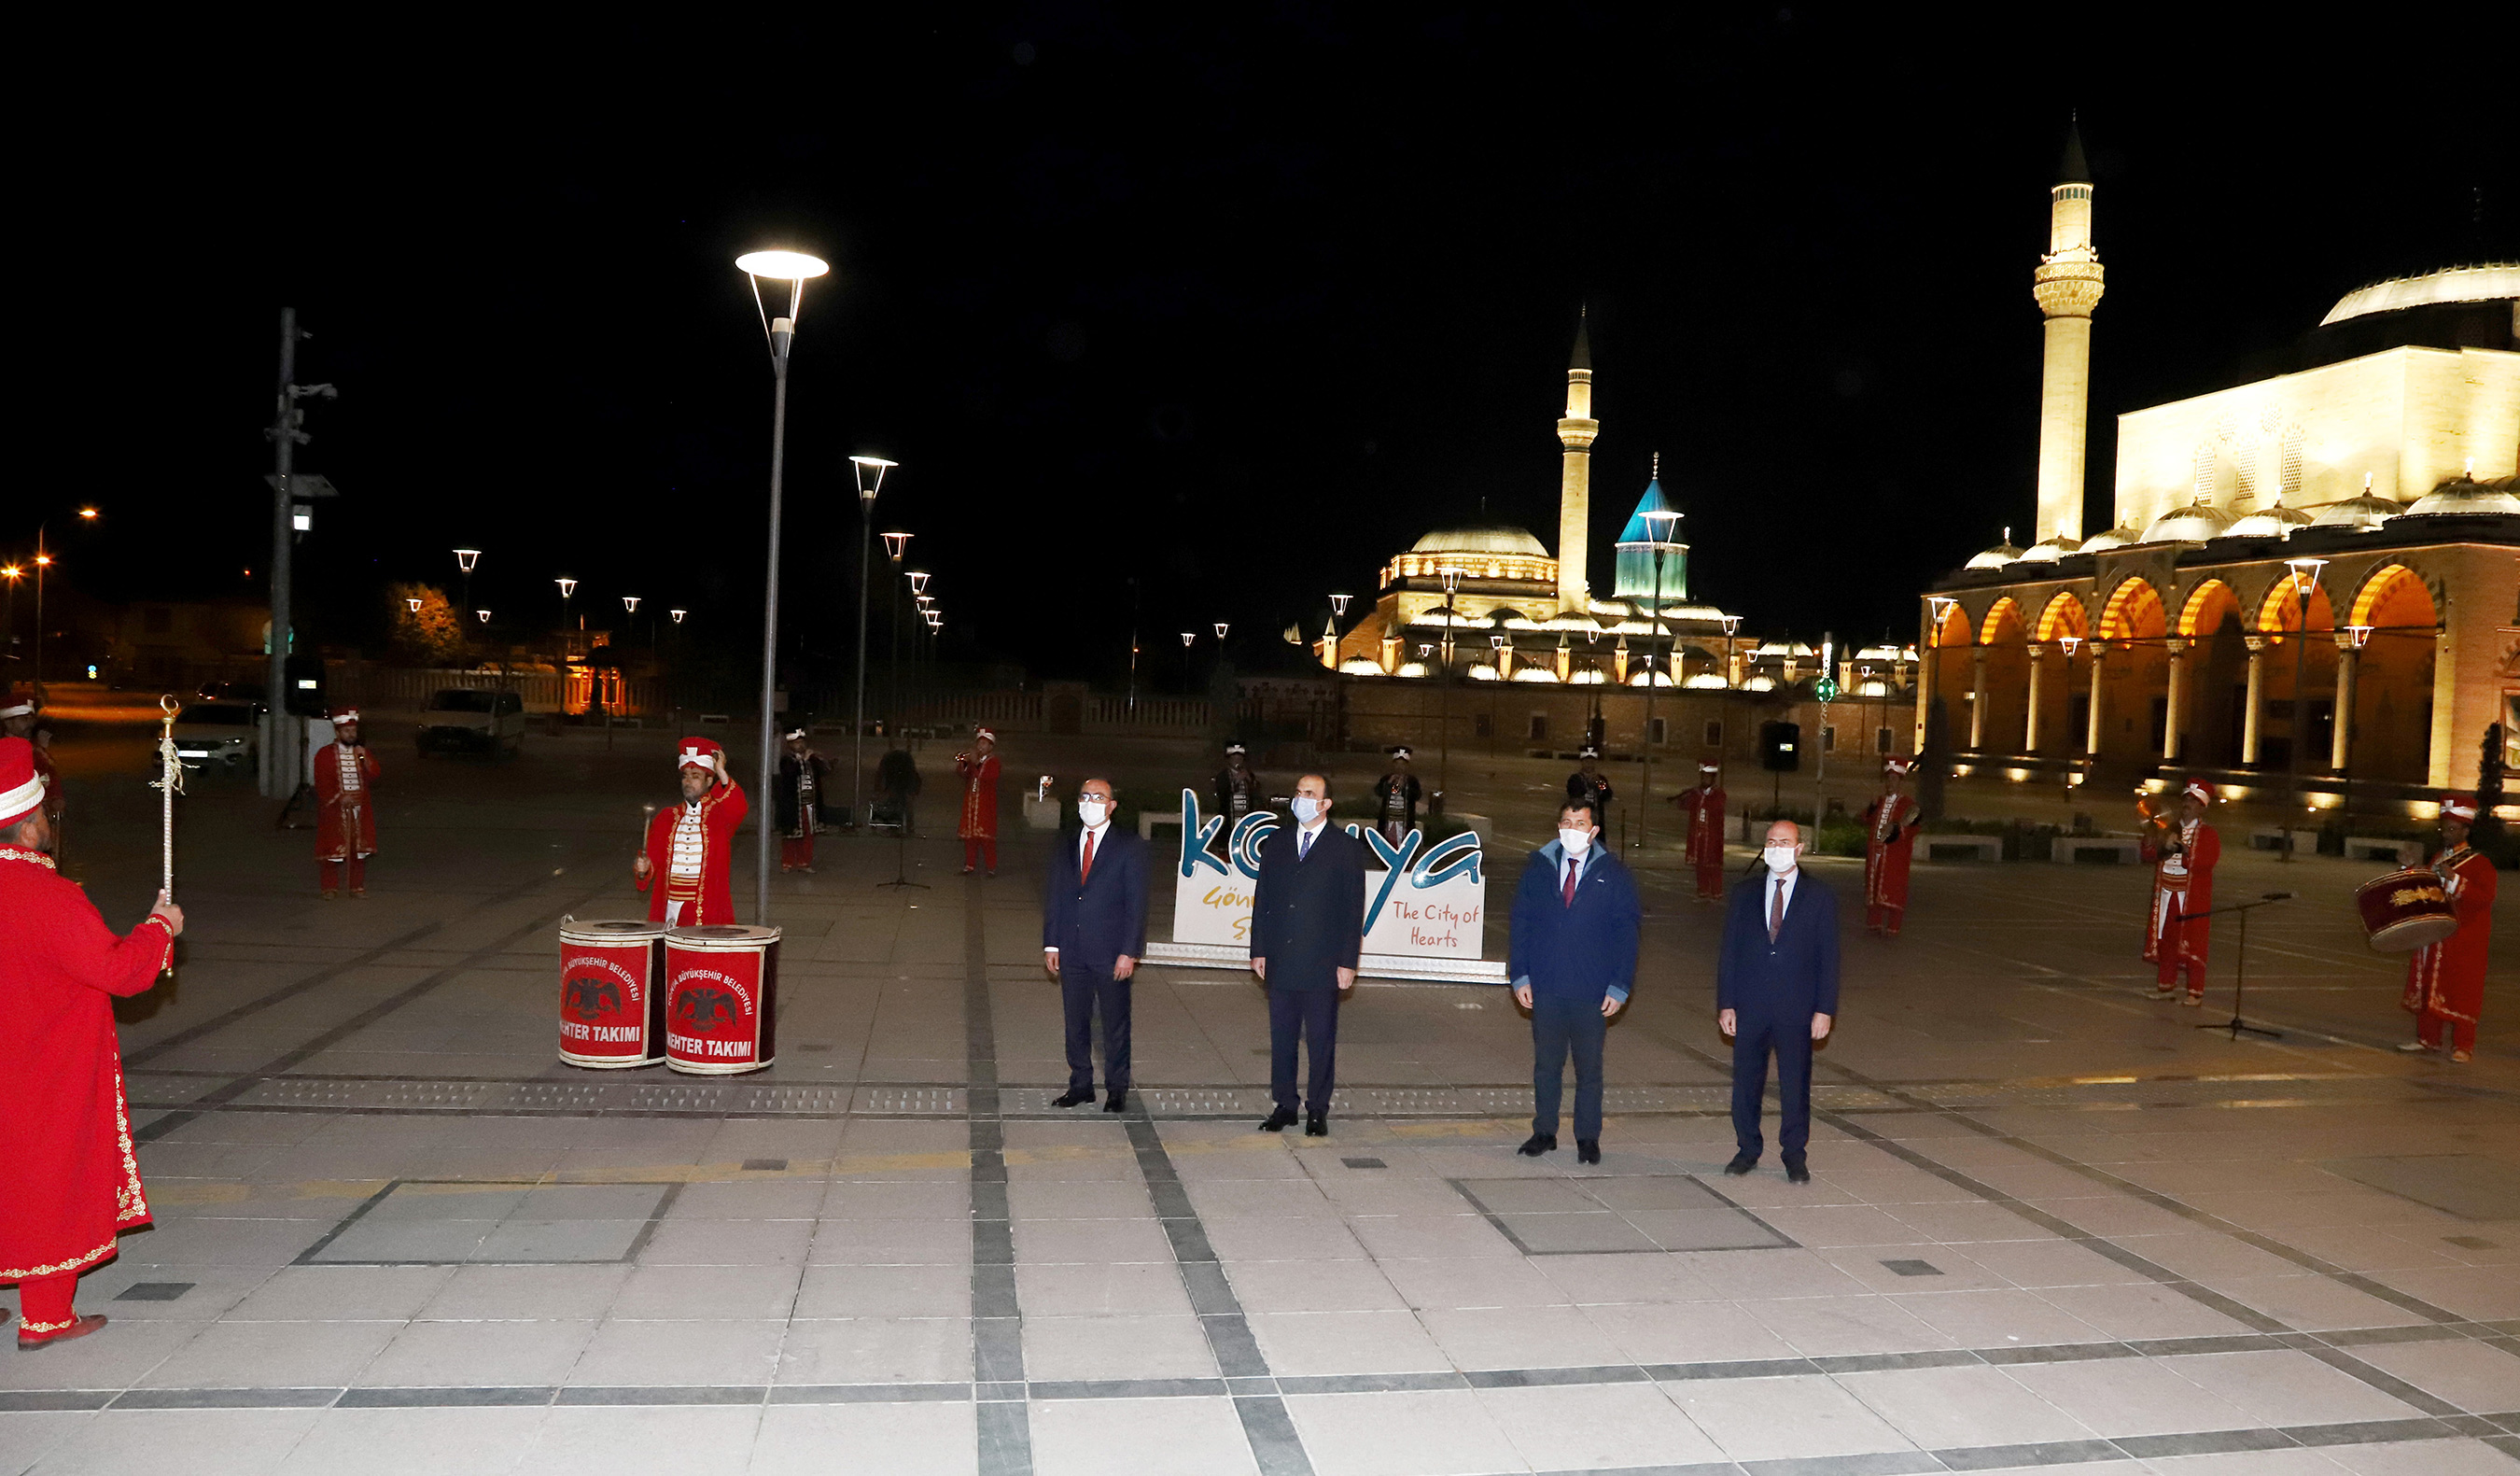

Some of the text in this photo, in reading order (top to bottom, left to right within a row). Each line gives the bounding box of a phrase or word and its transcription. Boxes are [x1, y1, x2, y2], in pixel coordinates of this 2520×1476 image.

[1181, 787, 1482, 937] koya
[1202, 886, 1255, 909] Gön
[1393, 901, 1479, 929] The City of
[1410, 926, 1458, 948] Hearts
[609, 962, 640, 1002] BELEDİYESİ
[678, 968, 722, 982] BÜYÜKŞEHİR
[723, 976, 753, 1016] BELEDİYESİ
[560, 1019, 640, 1042] EHTER TAKIMI
[707, 1040, 751, 1057] TAKIMI
